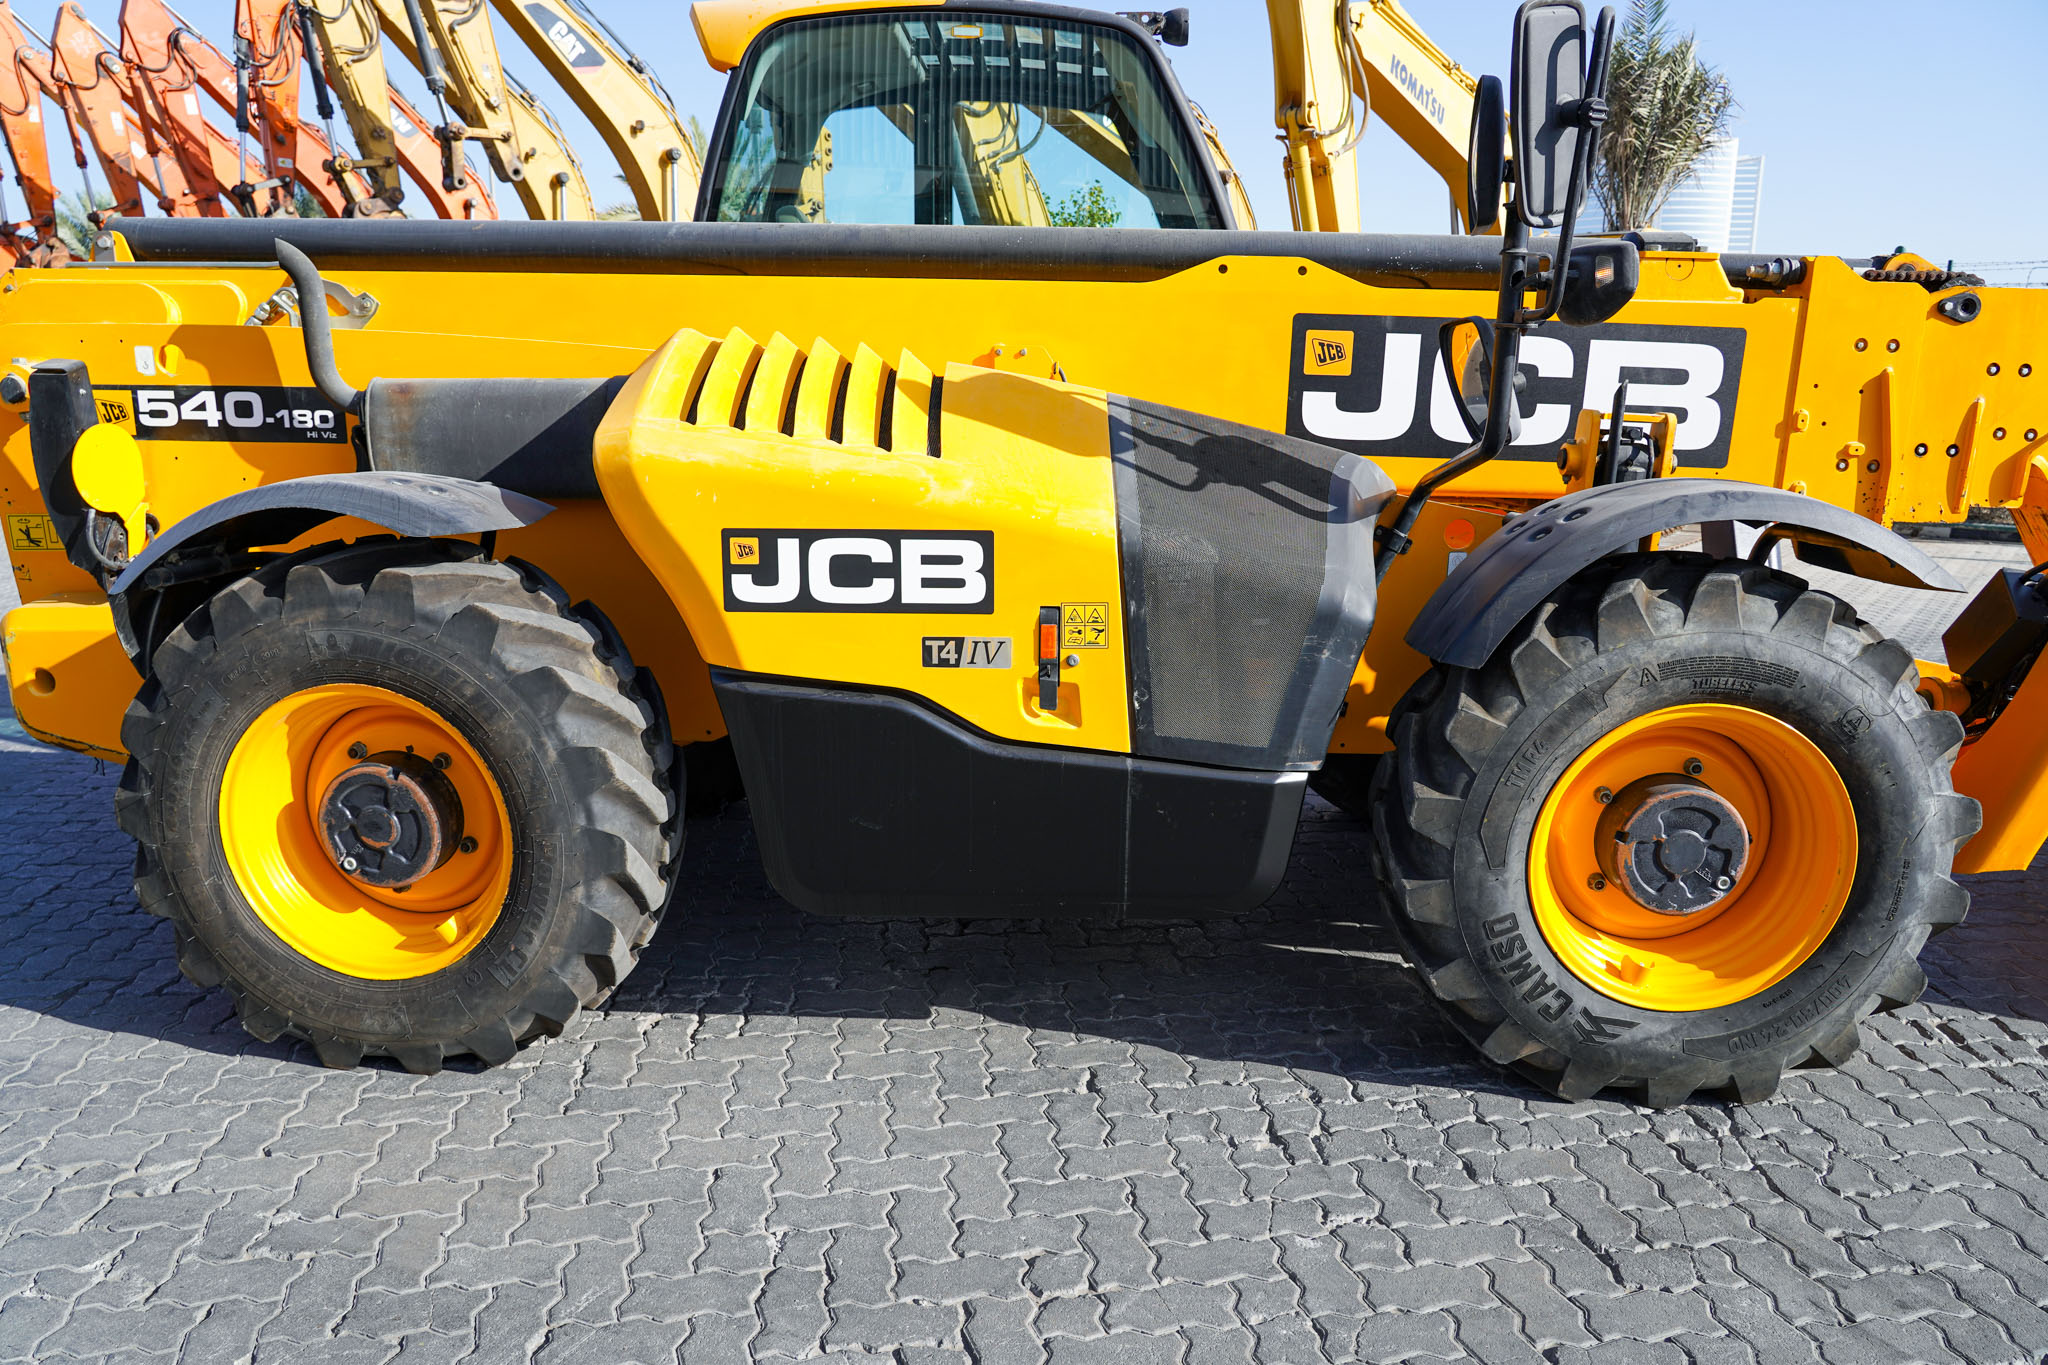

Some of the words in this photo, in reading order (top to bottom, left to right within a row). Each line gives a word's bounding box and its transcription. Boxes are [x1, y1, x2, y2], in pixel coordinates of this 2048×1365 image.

[548, 20, 586, 63] CAT
[1390, 53, 1445, 125] KOMATSU
[1317, 341, 1346, 364] JCB
[136, 389, 335, 428] 540-180
[1301, 332, 1725, 451] JCB
[101, 401, 127, 423] JCB
[306, 431, 319, 439] Hi
[321, 431, 337, 439] Viz
[730, 537, 987, 605] JCB
[736, 544, 755, 559] JCB
[923, 640, 958, 665] T4
[1483, 911, 1574, 1023] CAMSO
